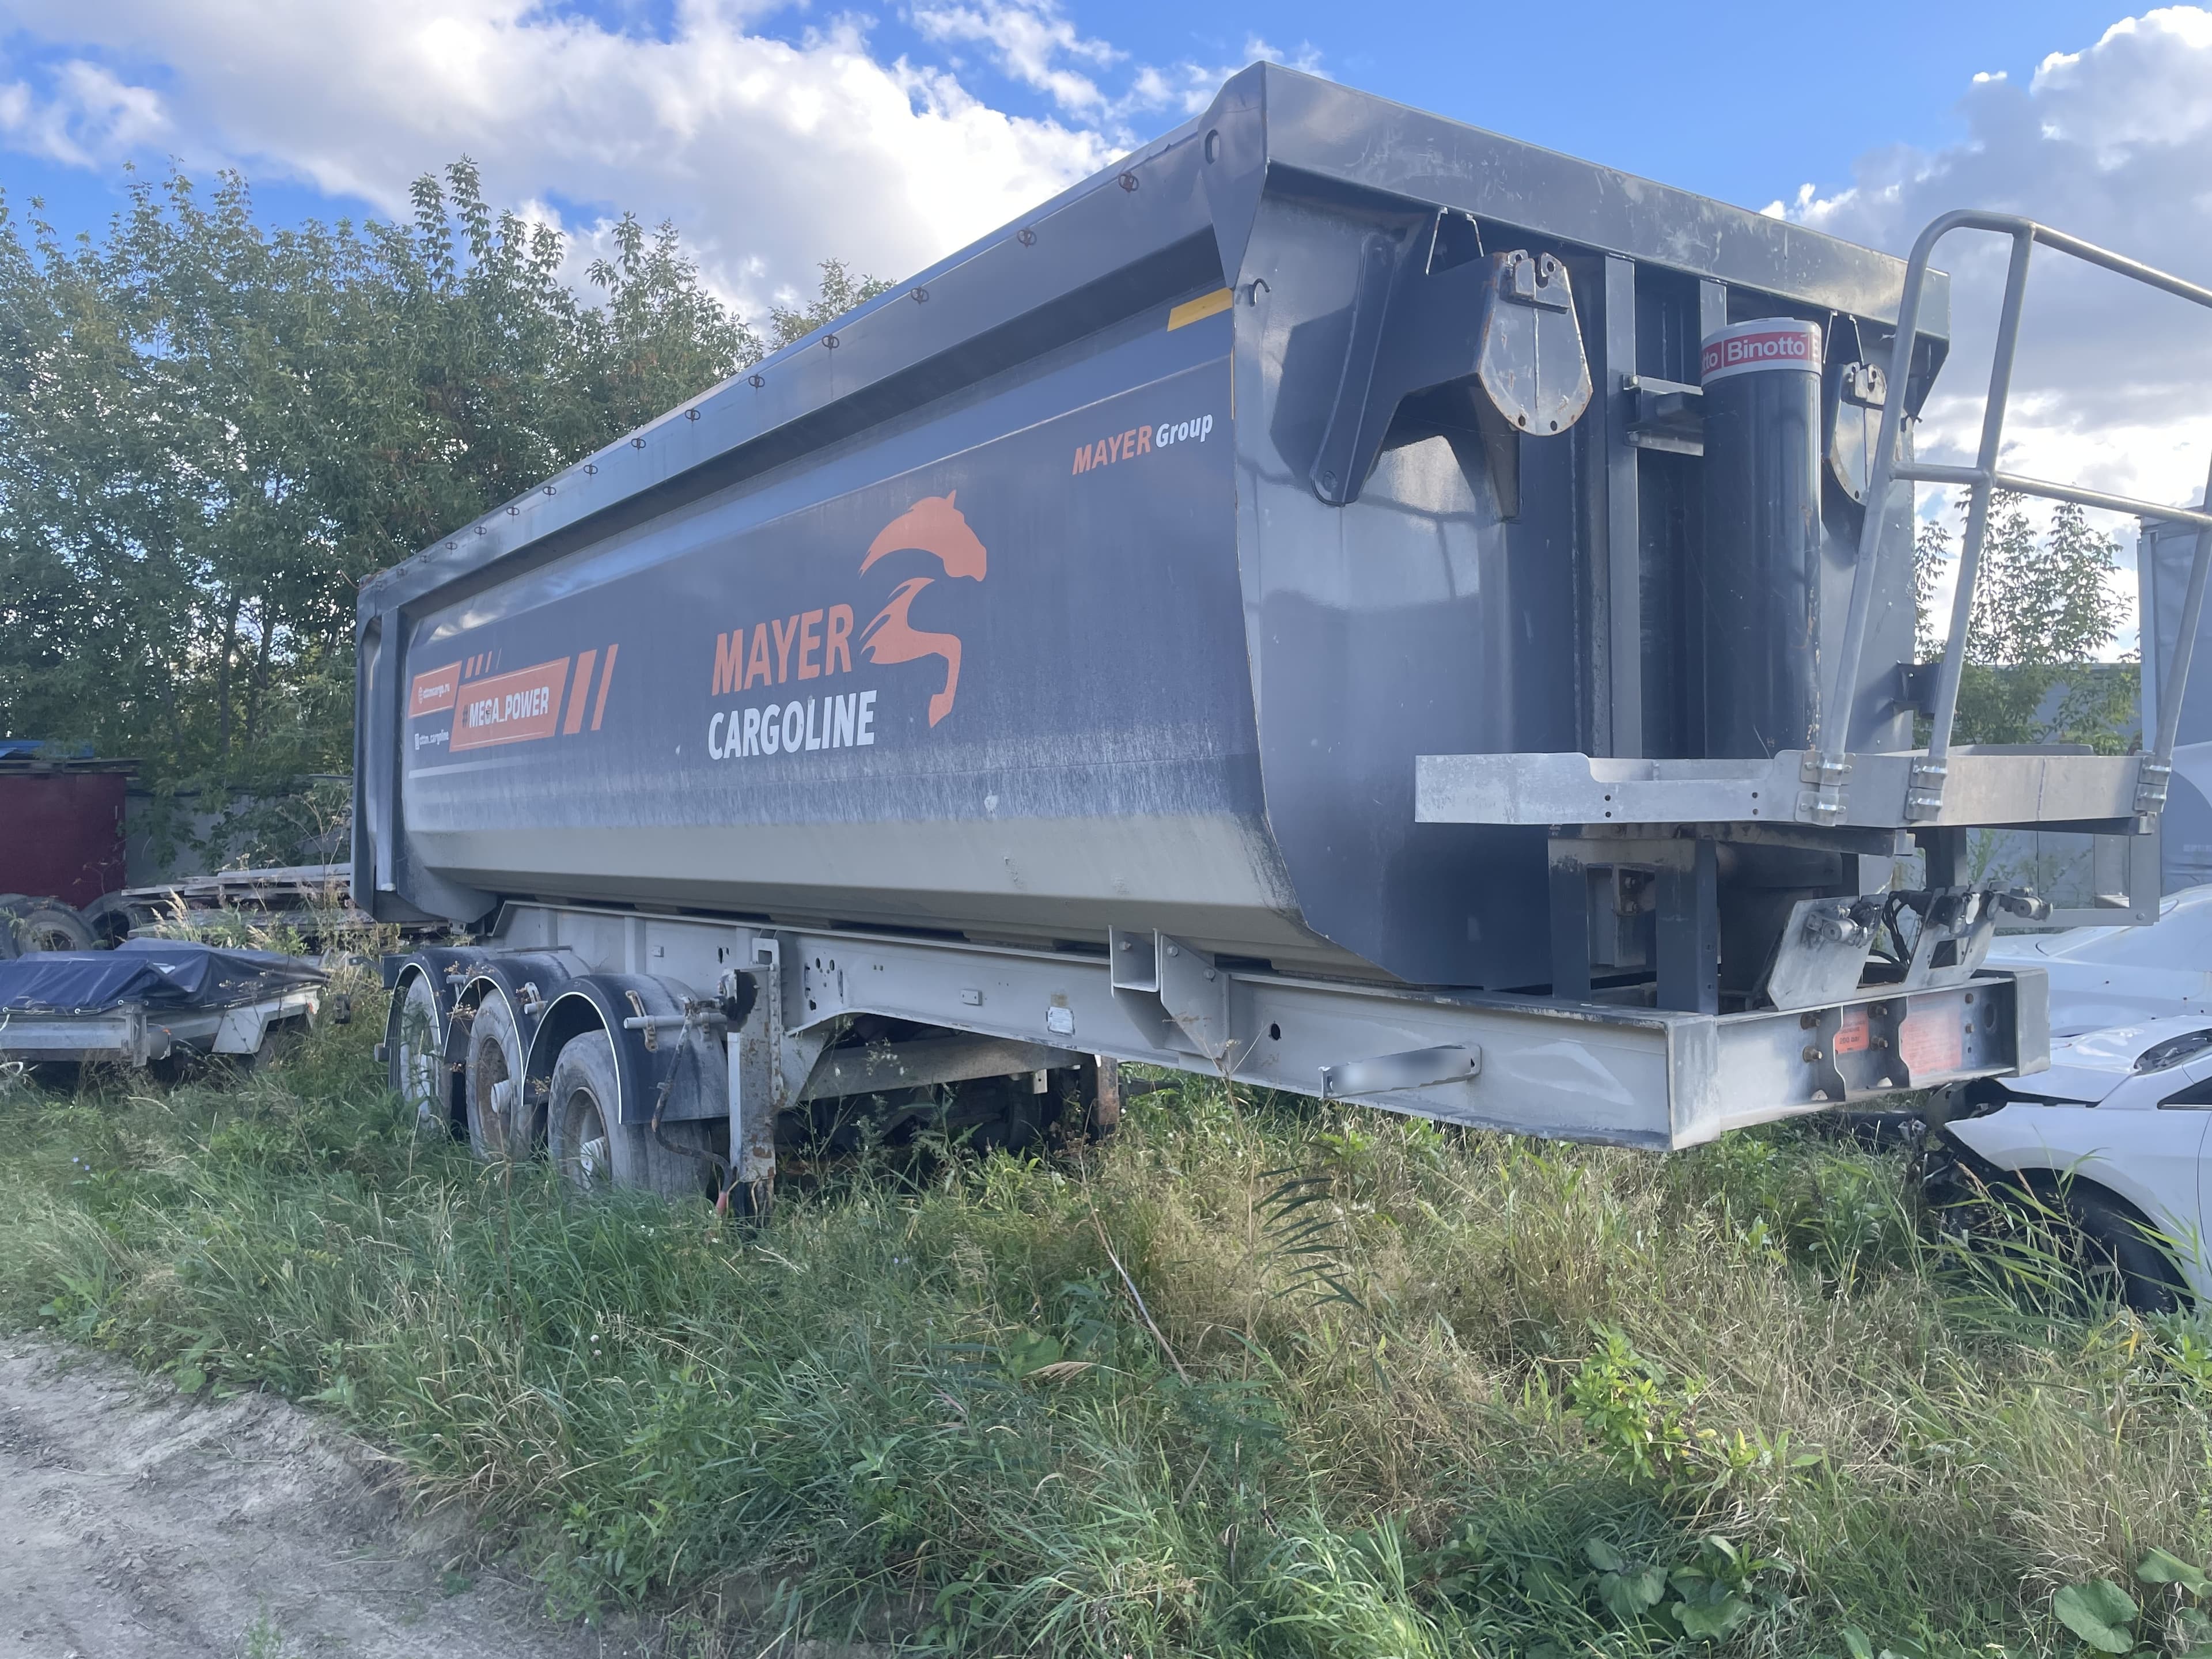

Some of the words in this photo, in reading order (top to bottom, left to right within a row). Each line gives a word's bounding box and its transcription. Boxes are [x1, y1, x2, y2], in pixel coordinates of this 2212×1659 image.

[1728, 336, 1805, 361] Binotto
[1072, 425, 1153, 475] MAYER
[1156, 414, 1213, 448] Group
[711, 604, 854, 696] MAYER
[462, 687, 549, 728] #MEGA_POWER
[708, 690, 877, 760] CARGOLINE
